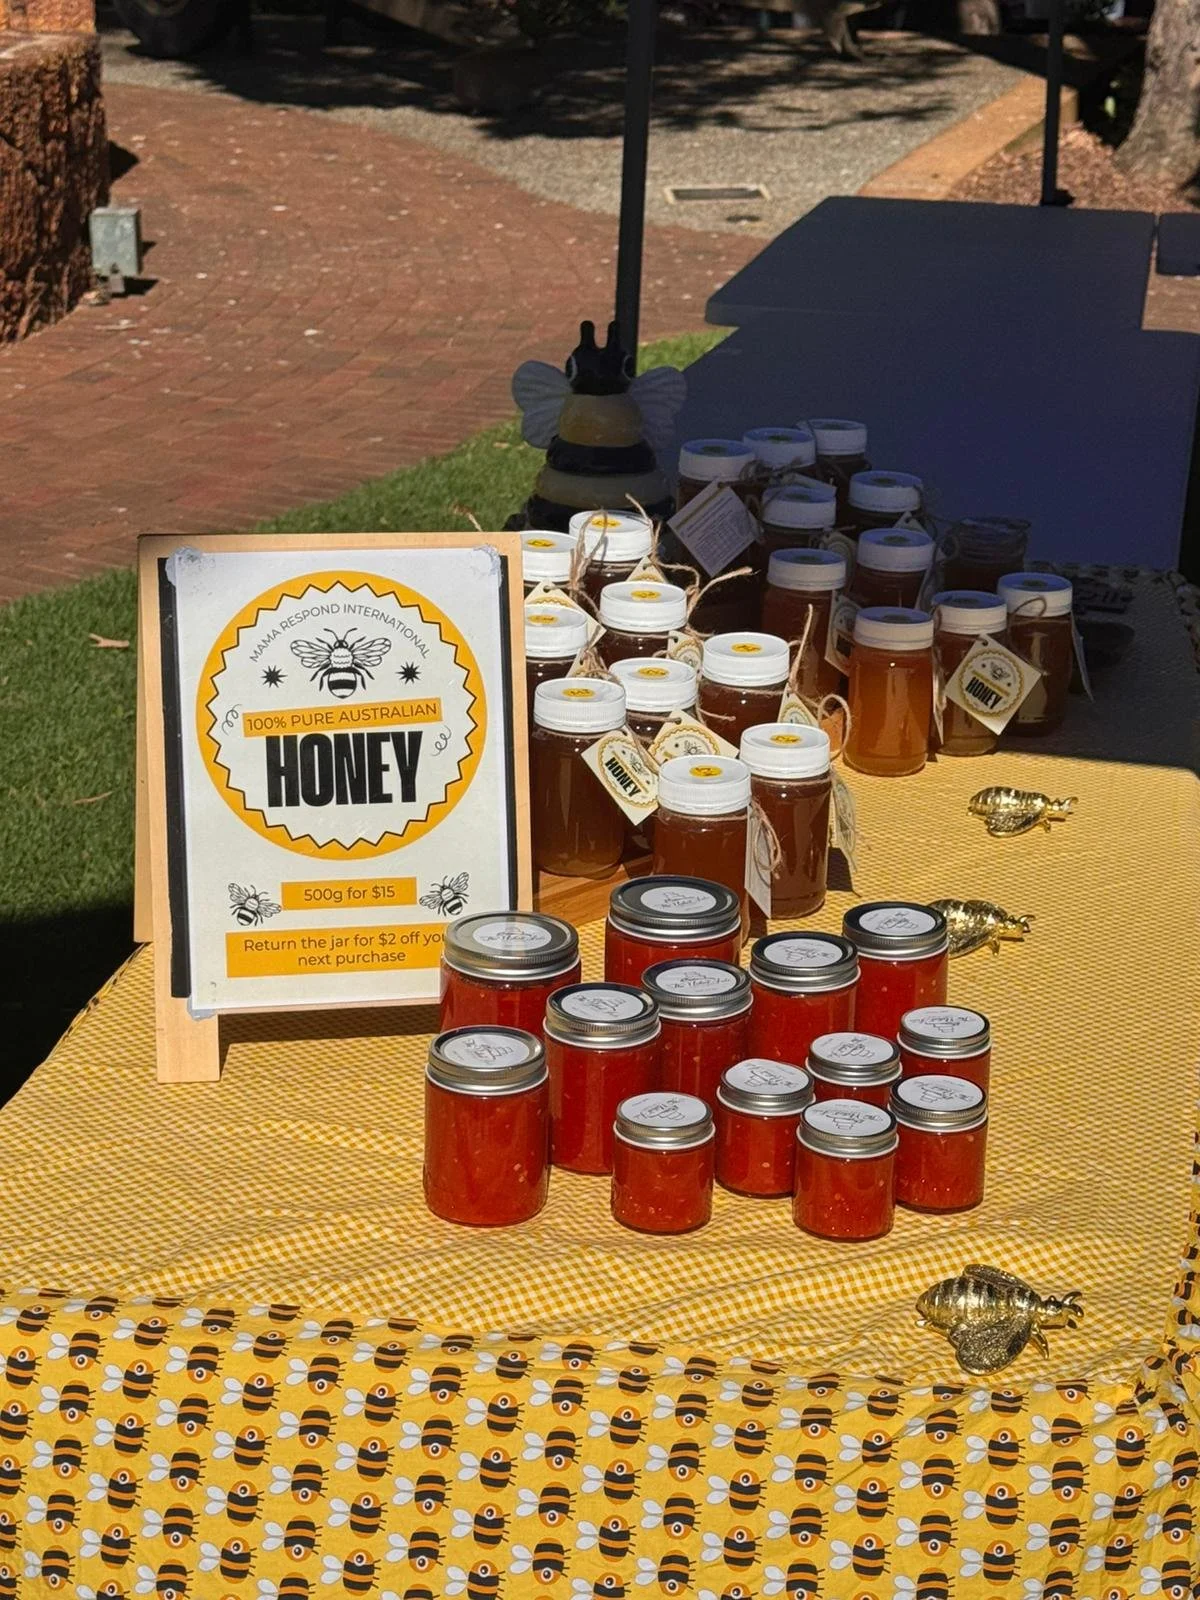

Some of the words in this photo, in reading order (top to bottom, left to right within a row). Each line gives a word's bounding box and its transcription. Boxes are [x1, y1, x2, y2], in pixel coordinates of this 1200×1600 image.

[250, 627, 282, 662] MAMA
[280, 603, 341, 632] RESPOND
[343, 604, 430, 659] INTERNATIONAL
[964, 676, 1003, 710] HONEY
[247, 716, 287, 731] 100%
[290, 712, 335, 727] PURE
[338, 703, 437, 723] AUSTRALIAN
[265, 730, 423, 807] HONEY
[604, 757, 642, 798] HONEY
[303, 887, 343, 903] 500g
[347, 886, 367, 900] for
[371, 884, 396, 899] $15
[243, 937, 297, 951] Return
[300, 932, 327, 949] the
[329, 932, 350, 951] jar
[354, 930, 374, 947] for
[378, 932, 396, 947] $2
[399, 931, 420, 945] off
[298, 953, 331, 966] next
[335, 949, 406, 967] purchase
